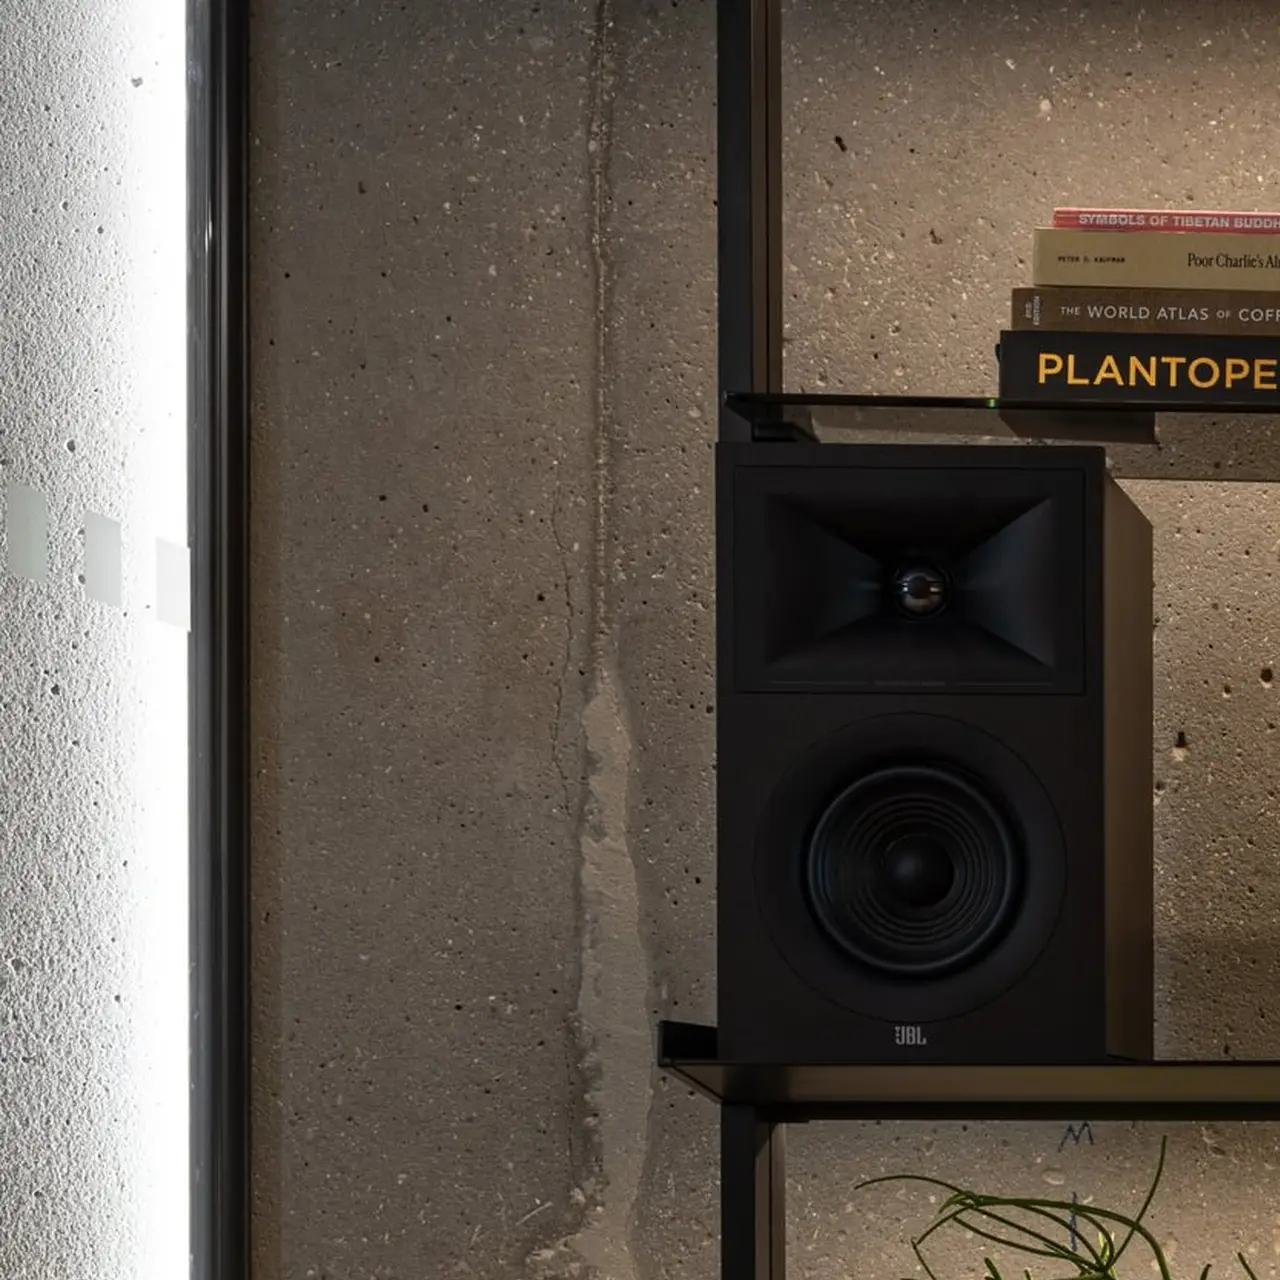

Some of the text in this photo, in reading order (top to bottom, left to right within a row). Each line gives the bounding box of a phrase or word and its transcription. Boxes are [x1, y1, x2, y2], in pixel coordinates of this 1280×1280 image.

[1079, 213, 1145, 226] SYMBOLS
[1150, 215, 1169, 226] OF
[1173, 215, 1230, 228] TIBETAN
[1187, 252, 1214, 268] Poor
[1215, 253, 1265, 269] Charlie's
[1060, 306, 1081, 316] THE
[1087, 305, 1150, 320] WORLD
[1156, 307, 1209, 321] ATLAS
[1216, 310, 1232, 319] OF
[894, 1025, 928, 1046] JBL
